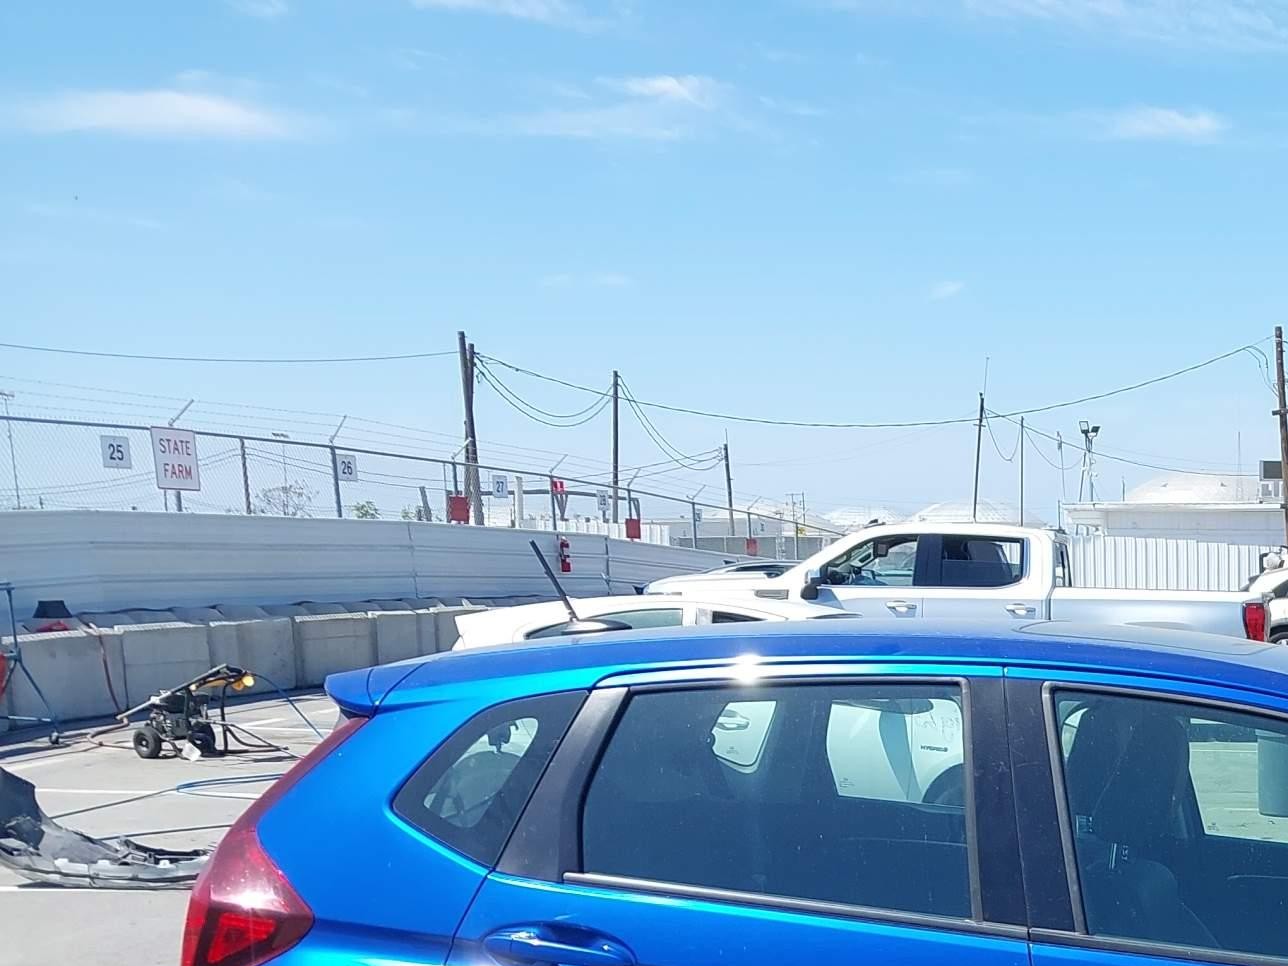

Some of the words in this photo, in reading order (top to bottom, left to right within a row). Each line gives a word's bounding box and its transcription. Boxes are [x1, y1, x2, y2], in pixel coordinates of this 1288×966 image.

[108, 443, 124, 461] 25
[159, 438, 192, 456] STATE
[163, 463, 193, 480] FARM
[341, 460, 353, 476] 26
[495, 480, 504, 493] 27
